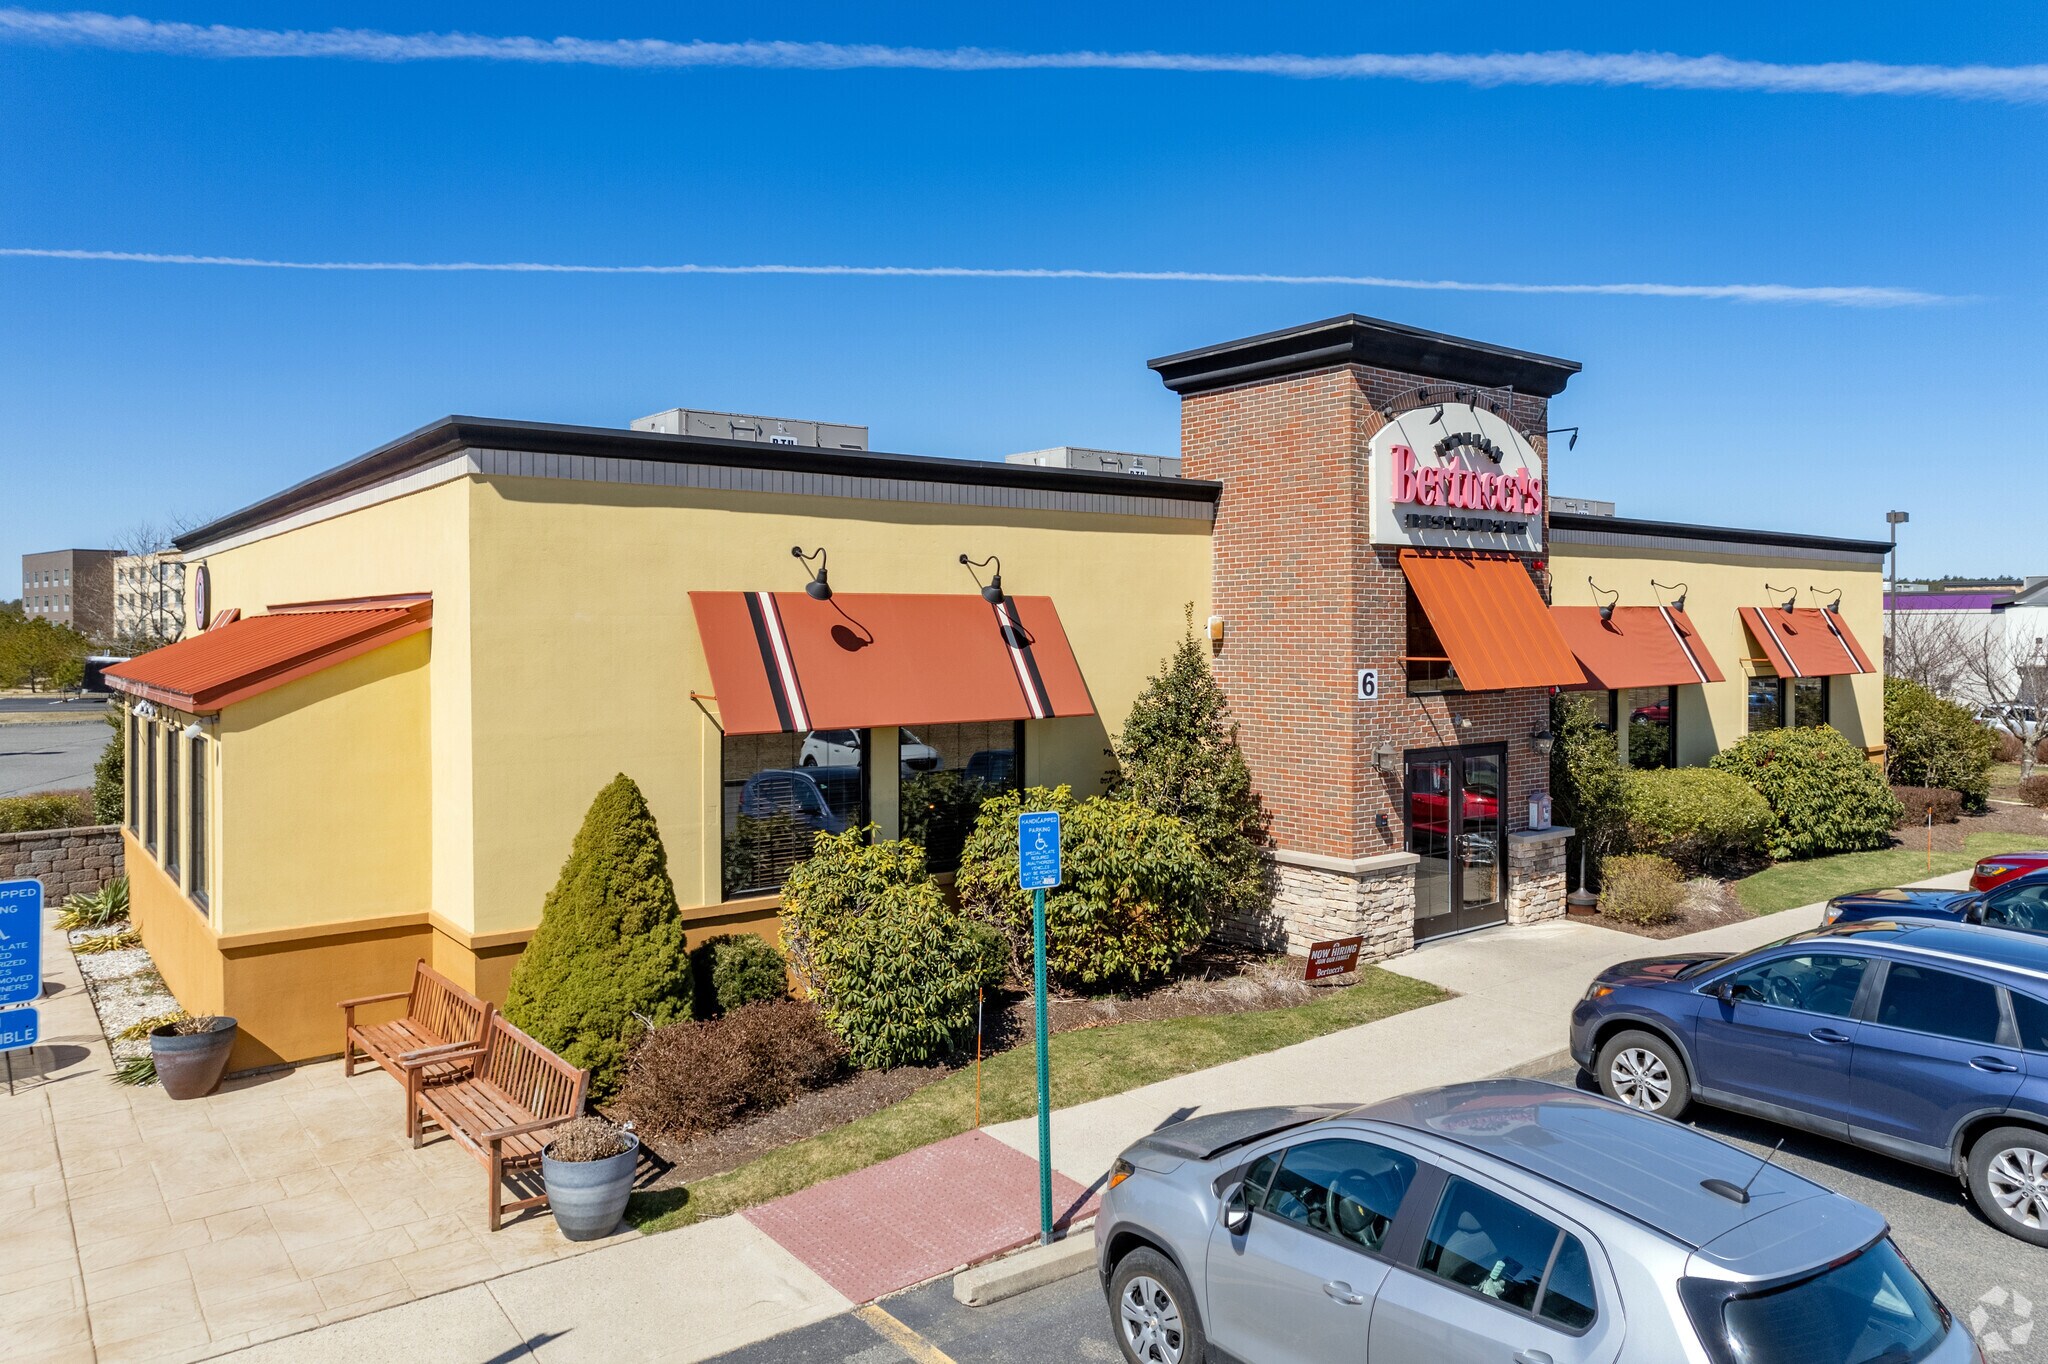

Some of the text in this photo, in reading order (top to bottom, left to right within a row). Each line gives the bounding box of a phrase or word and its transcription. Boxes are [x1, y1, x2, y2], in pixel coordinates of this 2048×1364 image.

[1389, 444, 1542, 516] Bertucci's
[1404, 513, 1529, 535] RESTAURANT
[1363, 672, 1375, 697] 6
[1022, 816, 1057, 825] HANDICAPPED
[1311, 943, 1358, 960] NOW HIRING
